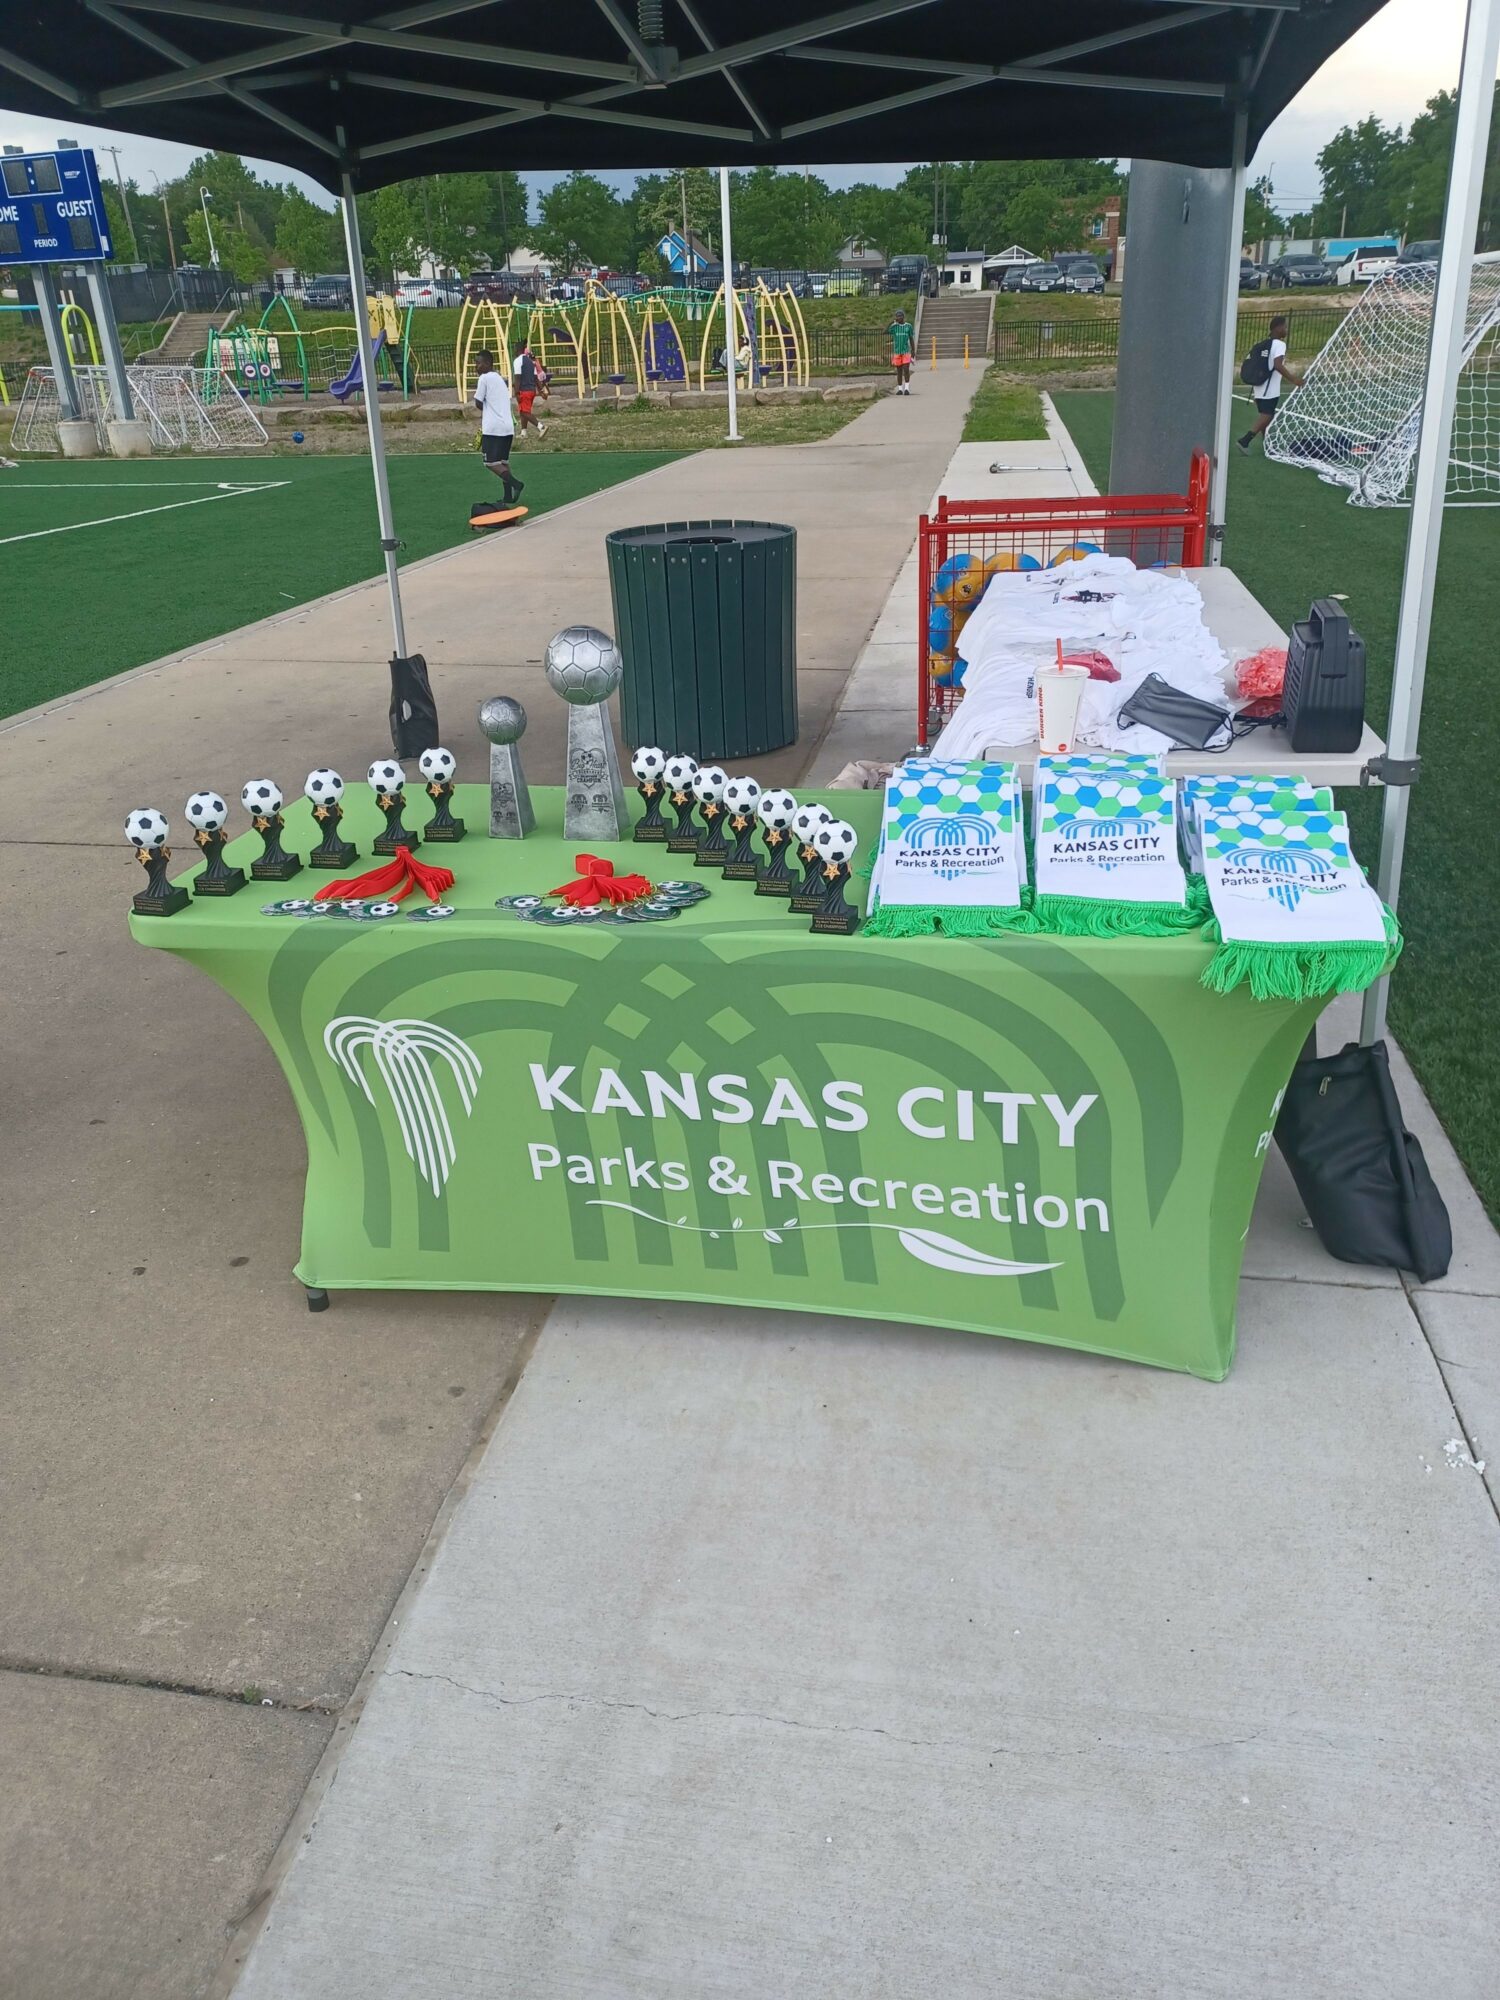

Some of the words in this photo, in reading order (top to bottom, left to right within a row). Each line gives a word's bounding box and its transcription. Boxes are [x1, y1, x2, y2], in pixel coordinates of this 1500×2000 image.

[0, 205, 20, 222] ME
[56, 200, 93, 218] GUEST
[34, 238, 58, 248] PERIOD
[899, 848, 961, 857] KANSAS
[966, 846, 1000, 857] CITY
[1053, 840, 1119, 854] KANSAS
[1123, 837, 1160, 850] CITY
[895, 859, 928, 868] Parks
[930, 859, 939, 868] &
[942, 856, 1004, 868] Recreation
[1050, 856, 1084, 864] Parks
[1086, 855, 1095, 863] &
[1098, 853, 1165, 863] Recreation
[1221, 876, 1259, 886] Parks
[1299, 871, 1338, 883] CITY
[528, 1063, 869, 1132] KANSAS
[897, 1086, 1099, 1147] CITY
[527, 1142, 690, 1191] Parks
[708, 1155, 751, 1196] &
[767, 1159, 1110, 1232] Recreation
